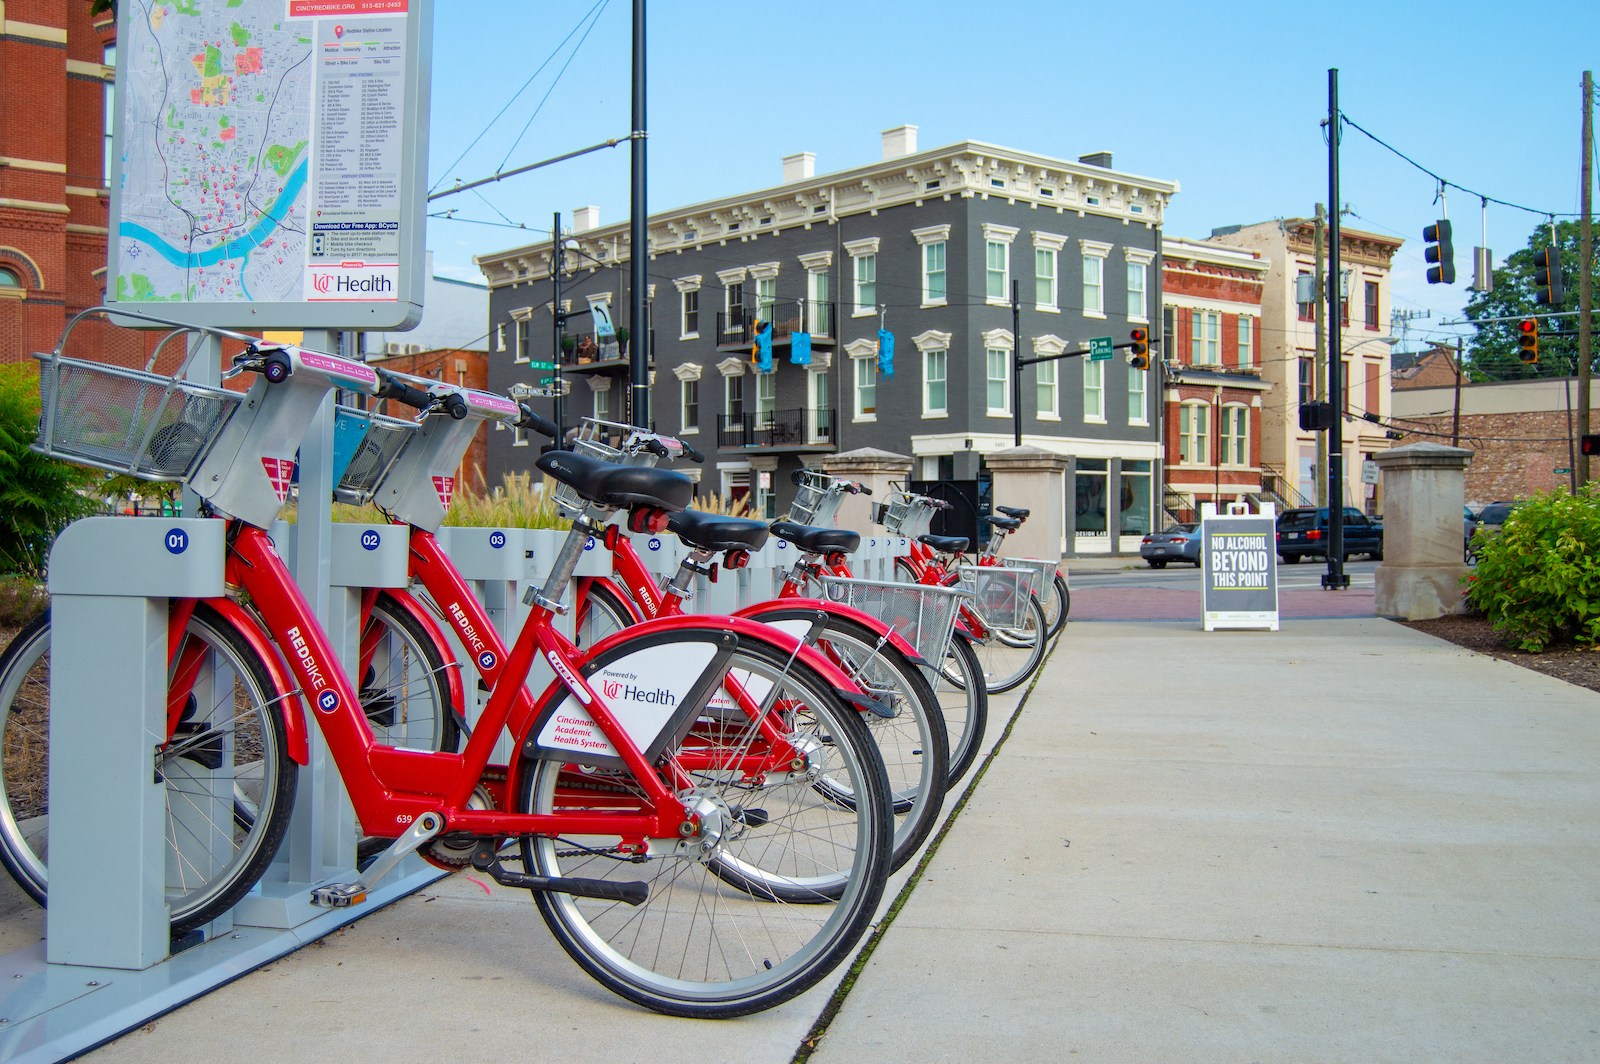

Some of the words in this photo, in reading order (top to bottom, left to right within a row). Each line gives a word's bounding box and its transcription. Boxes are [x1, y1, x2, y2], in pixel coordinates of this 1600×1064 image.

[337, 275, 390, 291] Health
[599, 325, 612, 333] ONLY
[1091, 341, 1111, 355] PARKING
[168, 534, 184, 547] 01
[363, 535, 377, 545] 02
[491, 536, 503, 545] 03
[1212, 537, 1224, 550] NO
[1227, 537, 1267, 550] ALCOHOL
[1212, 551, 1268, 571] BEYOND
[1213, 572, 1236, 586] THIS
[1238, 572, 1268, 586] POINT
[639, 586, 657, 618] REDBIK
[449, 602, 485, 652] REDBIKE
[287, 626, 326, 690] REDBIKE
[482, 655, 492, 665] B
[551, 654, 577, 685] TREK
[603, 670, 629, 678] Powered
[630, 672, 637, 680] by
[322, 694, 335, 708] B
[624, 685, 675, 706] Health
[556, 715, 599, 728] Cincinnati
[555, 726, 592, 737] Academic
[554, 736, 579, 745] Health
[580, 739, 607, 749] System
[396, 815, 412, 823] 639
